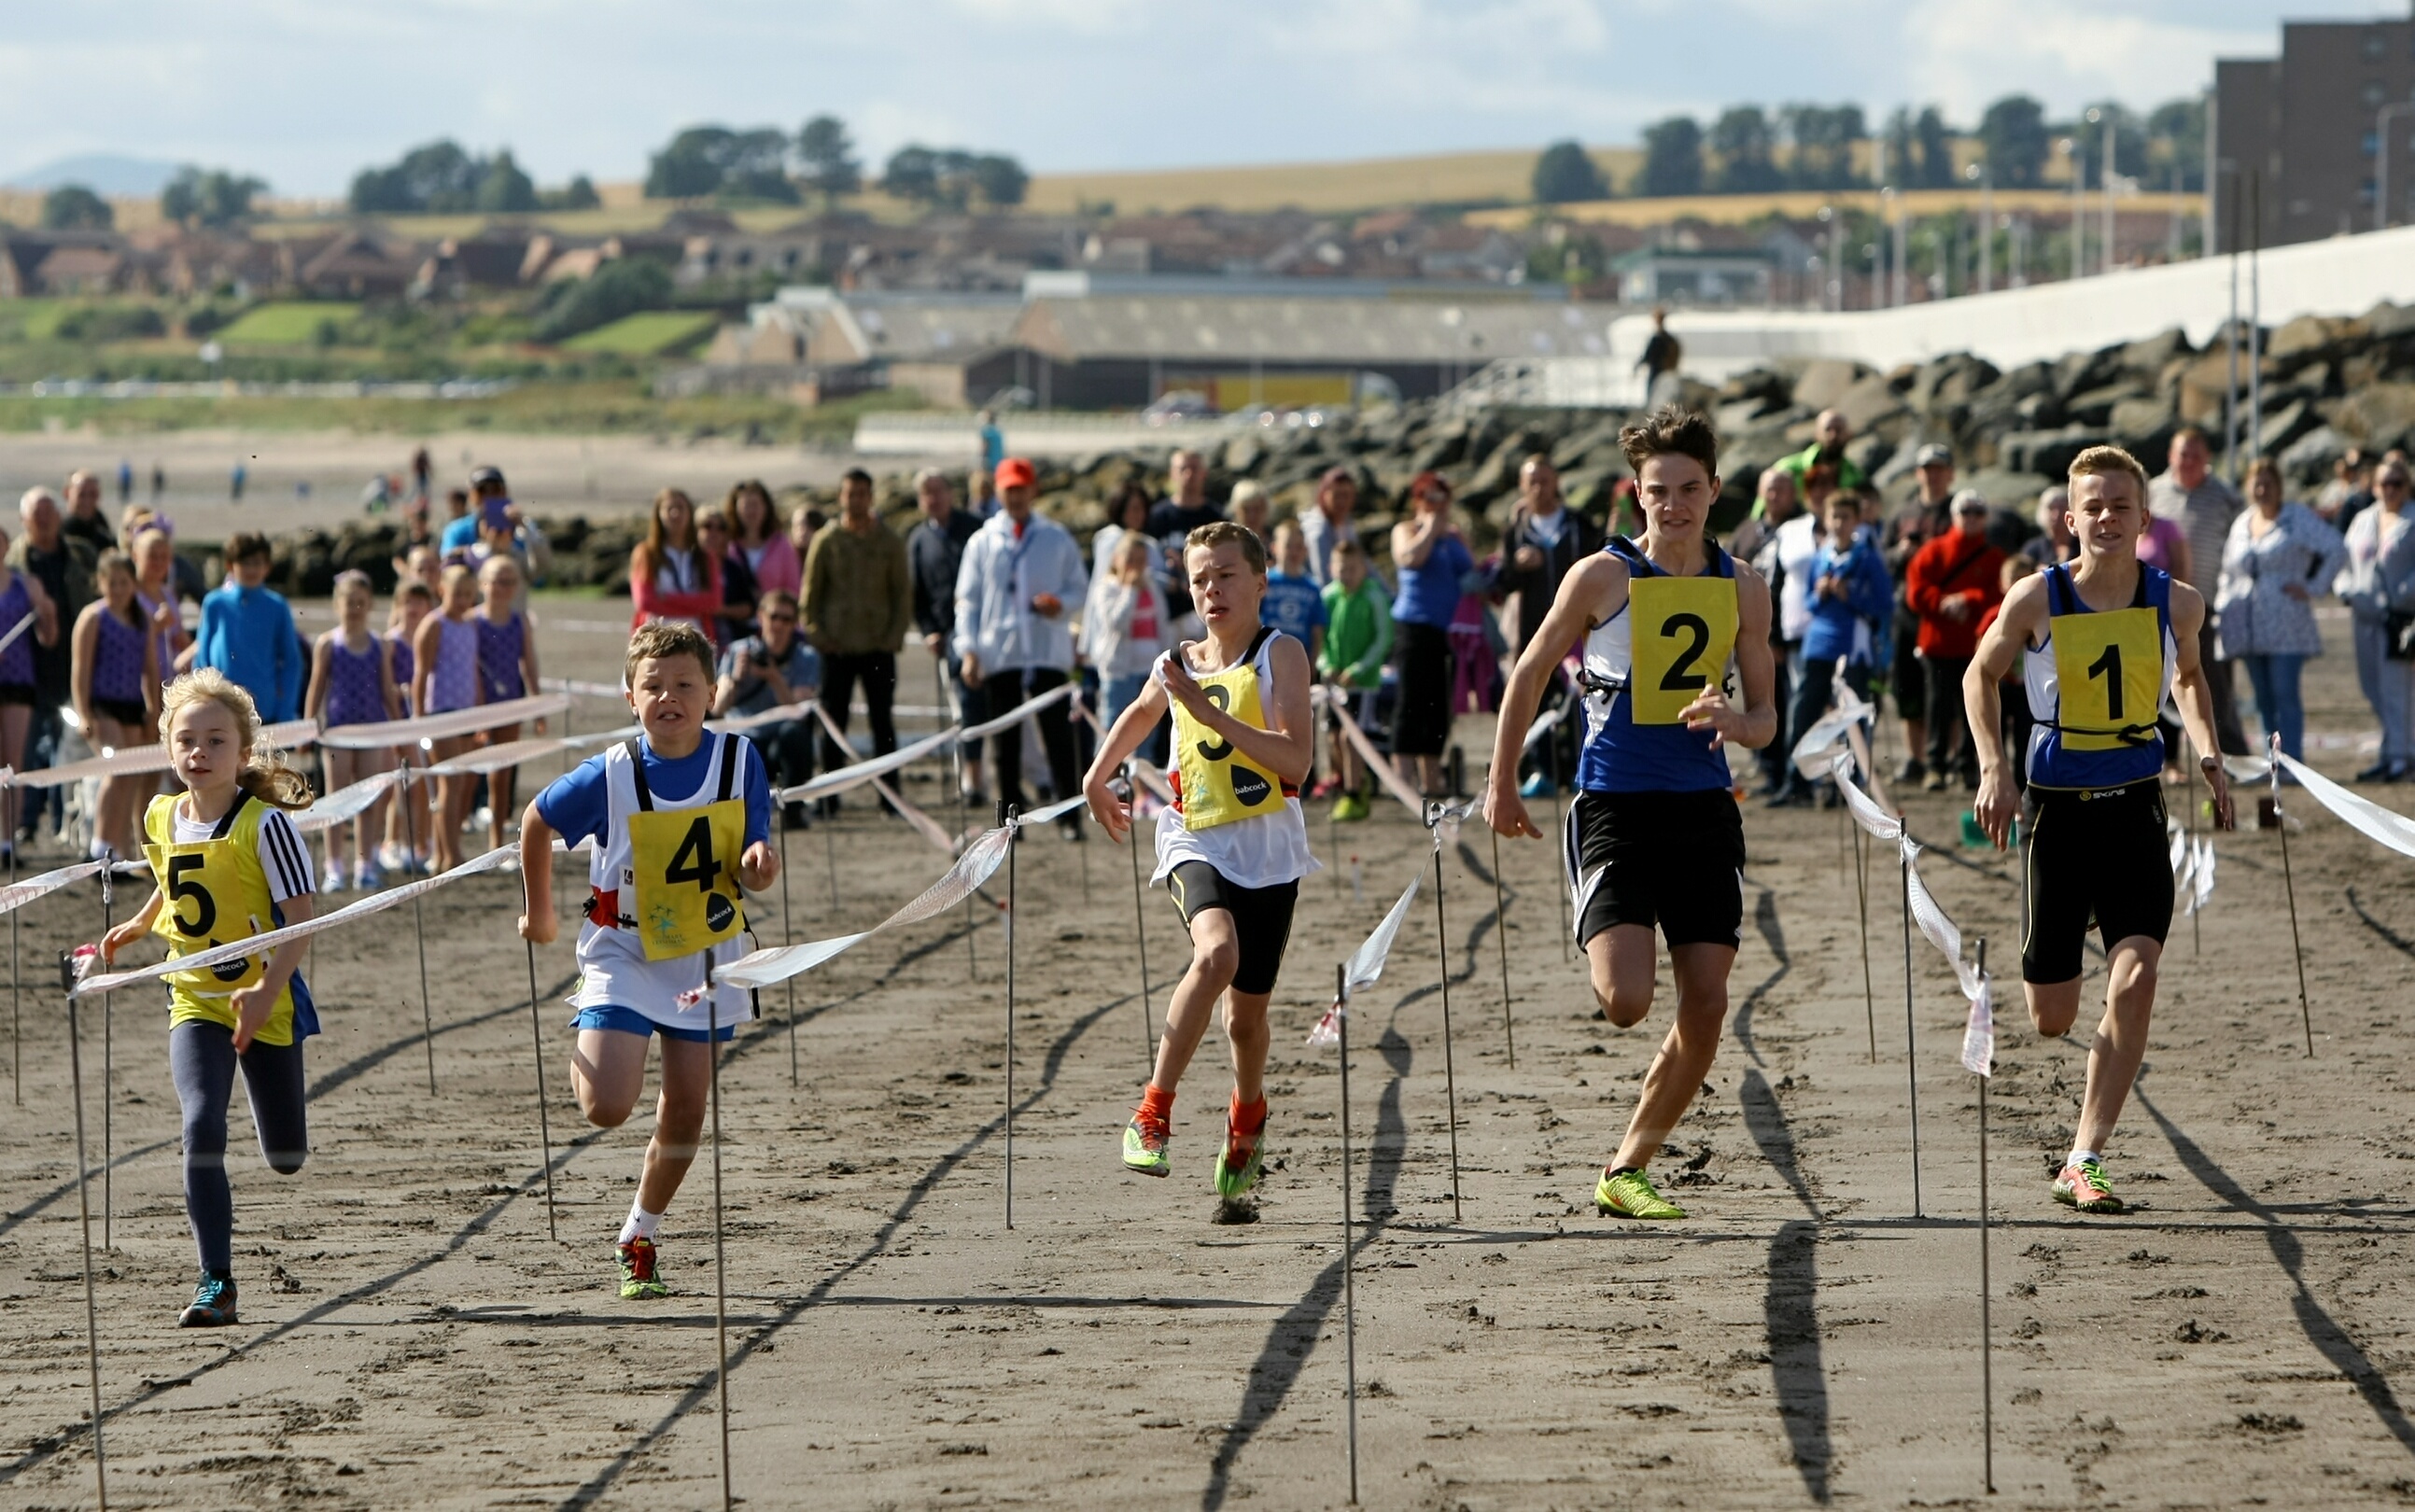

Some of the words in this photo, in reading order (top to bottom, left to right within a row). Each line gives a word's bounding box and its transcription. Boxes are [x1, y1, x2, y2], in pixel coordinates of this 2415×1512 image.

[1659, 612, 1709, 691] 2
[2088, 644, 2124, 721] 1
[1196, 684, 1235, 762] 3
[1234, 781, 1268, 795] babcock
[665, 816, 722, 893] 4
[168, 853, 217, 937] 5
[707, 905, 733, 925] babcock
[211, 959, 246, 973] babcock
